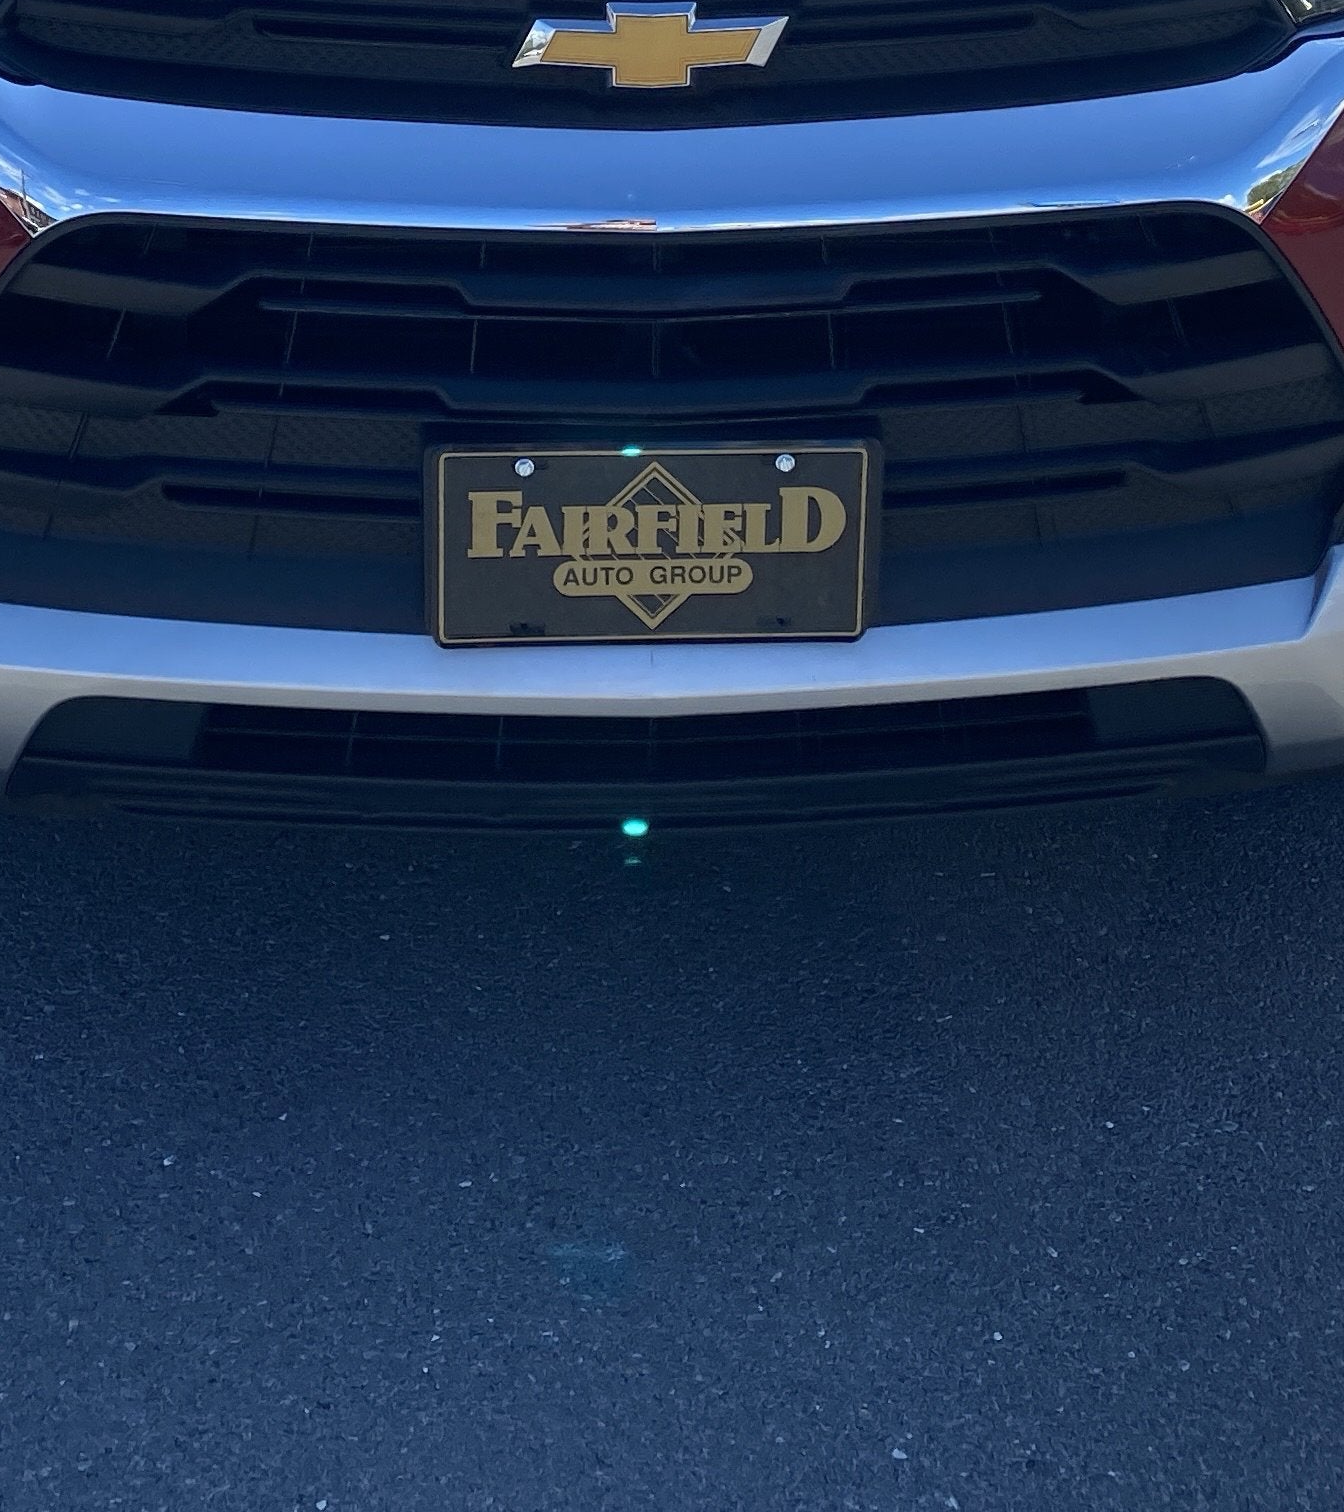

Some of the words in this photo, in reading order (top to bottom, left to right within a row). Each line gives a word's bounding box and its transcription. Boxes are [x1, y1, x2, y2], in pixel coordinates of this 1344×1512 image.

[467, 486, 847, 558] FAIRFIELD
[562, 565, 634, 587] AUTO
[649, 564, 743, 585] GROUP
